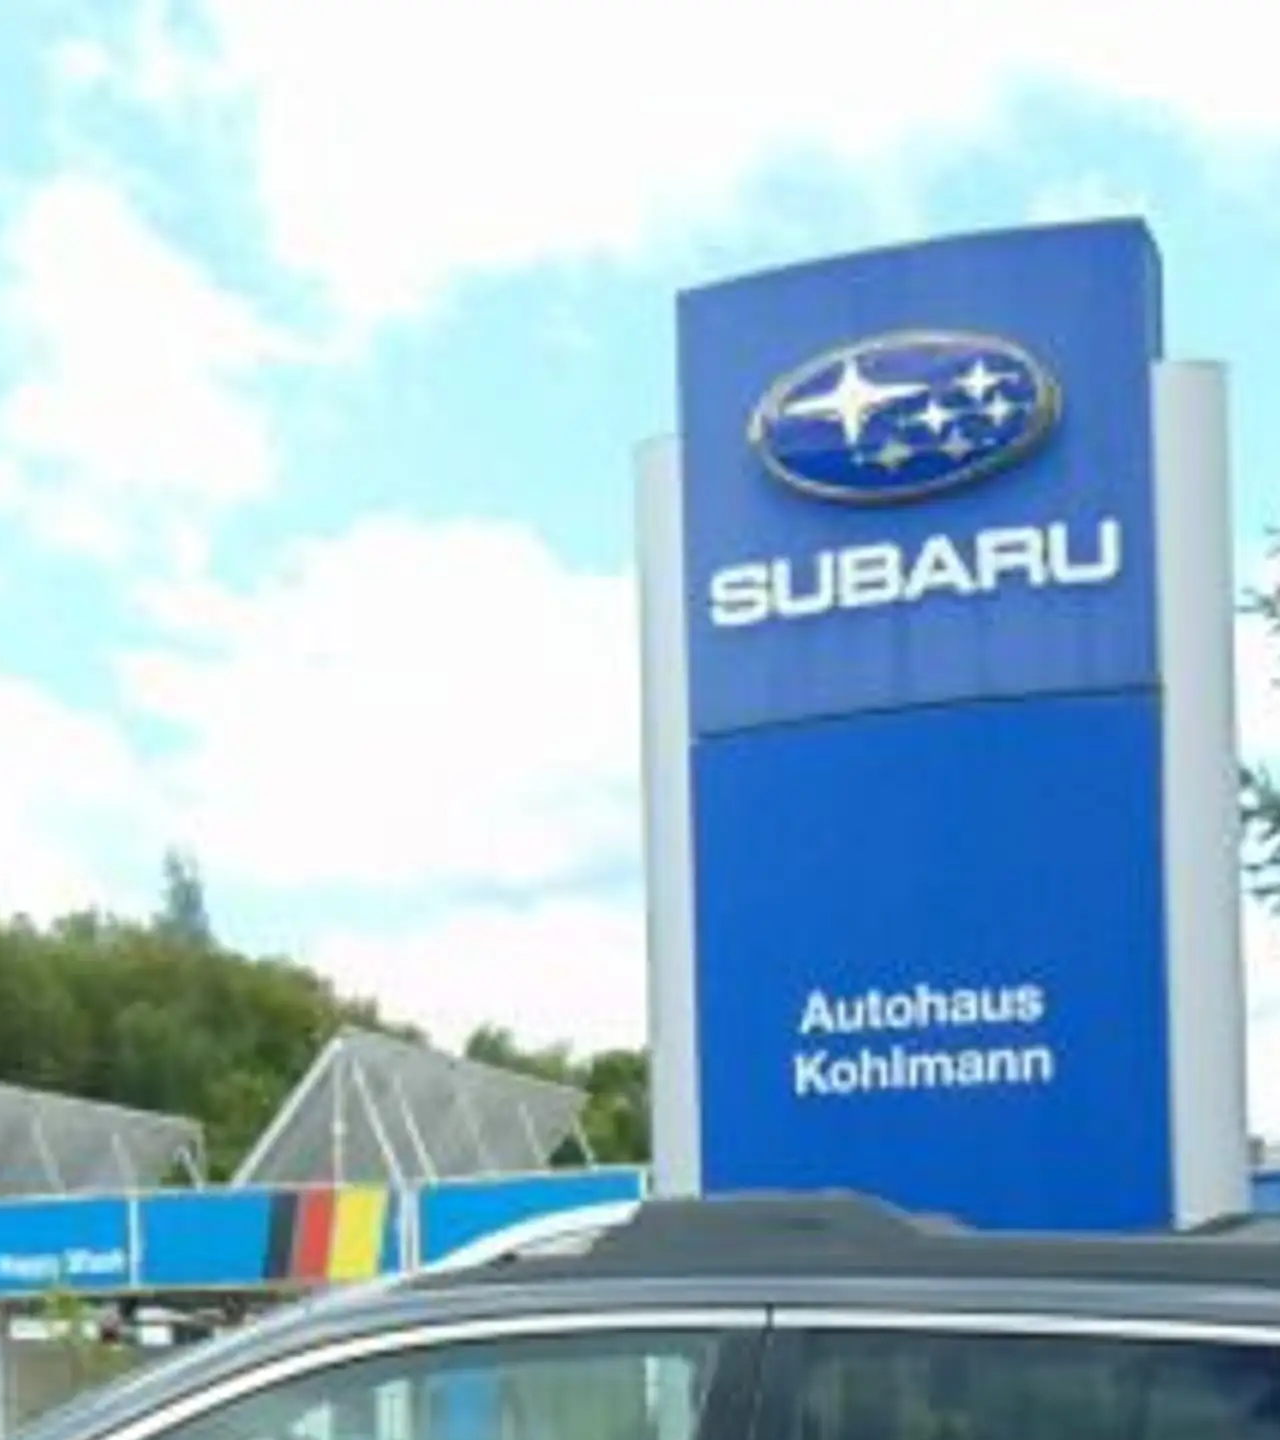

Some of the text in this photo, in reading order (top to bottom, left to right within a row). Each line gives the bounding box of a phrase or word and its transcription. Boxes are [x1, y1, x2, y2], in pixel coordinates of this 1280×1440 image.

[710, 516, 1120, 627] SUBARU
[799, 983, 1045, 1034] Autohaus
[793, 1045, 1054, 1096] Kohlmann
